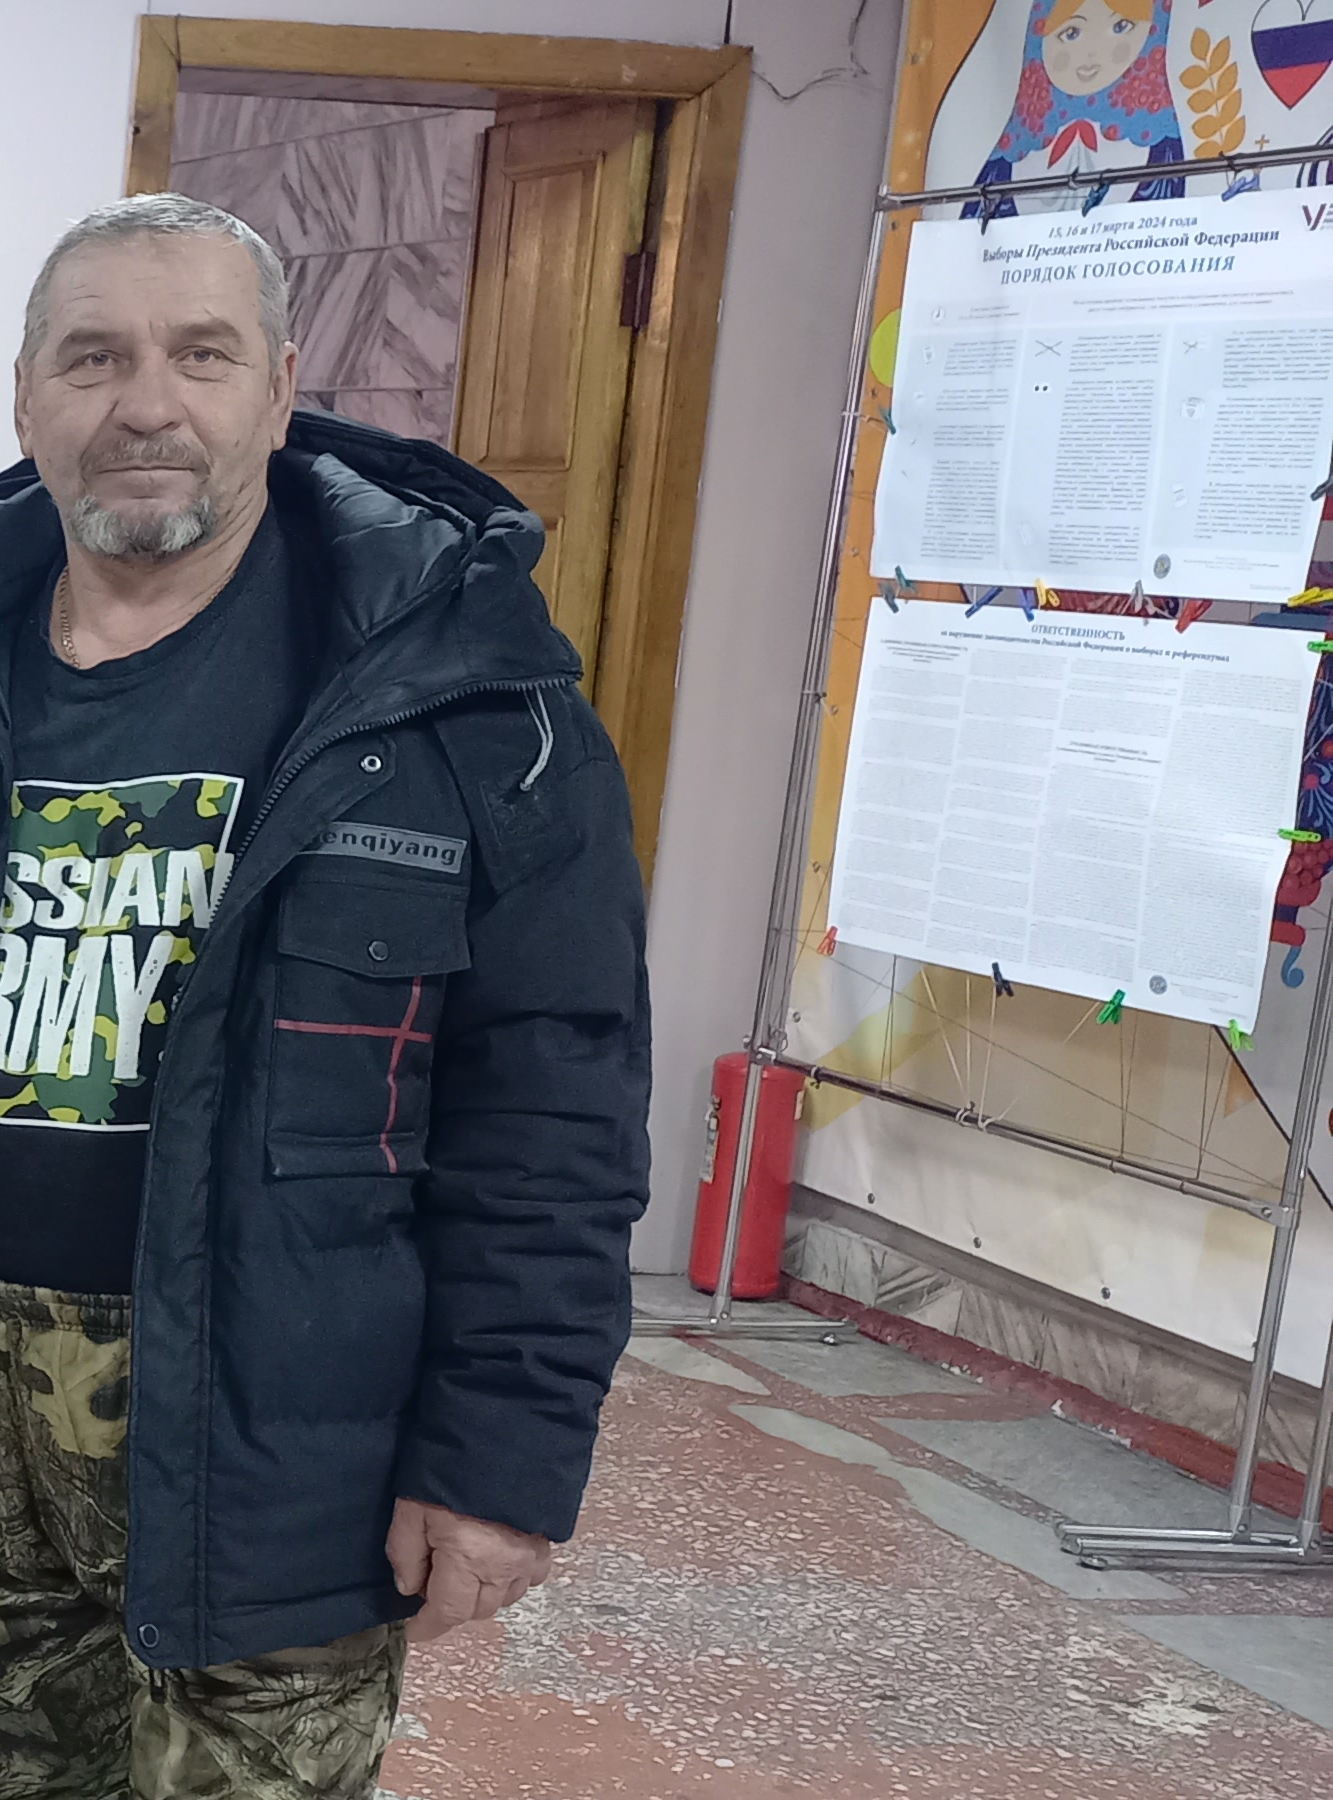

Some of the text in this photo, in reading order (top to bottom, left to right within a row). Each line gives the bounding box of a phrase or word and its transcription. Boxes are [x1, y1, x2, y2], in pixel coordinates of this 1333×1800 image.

[1066, 225, 1079, 238] 16
[1080, 226, 1089, 236] и
[1090, 222, 1103, 236] 17
[1102, 220, 1134, 235] марта
[1137, 216, 1167, 230] 2024
[1168, 217, 1198, 228] года
[982, 231, 1280, 263] Выборы Президента Российской Федерации
[1000, 255, 1236, 285] ПОРЯДОК ГОЛОСОВАНИЯ
[1031, 624, 1126, 641] ОТВЕТСТВЕННОСТЬ
[313, 830, 458, 866] enqiyang
